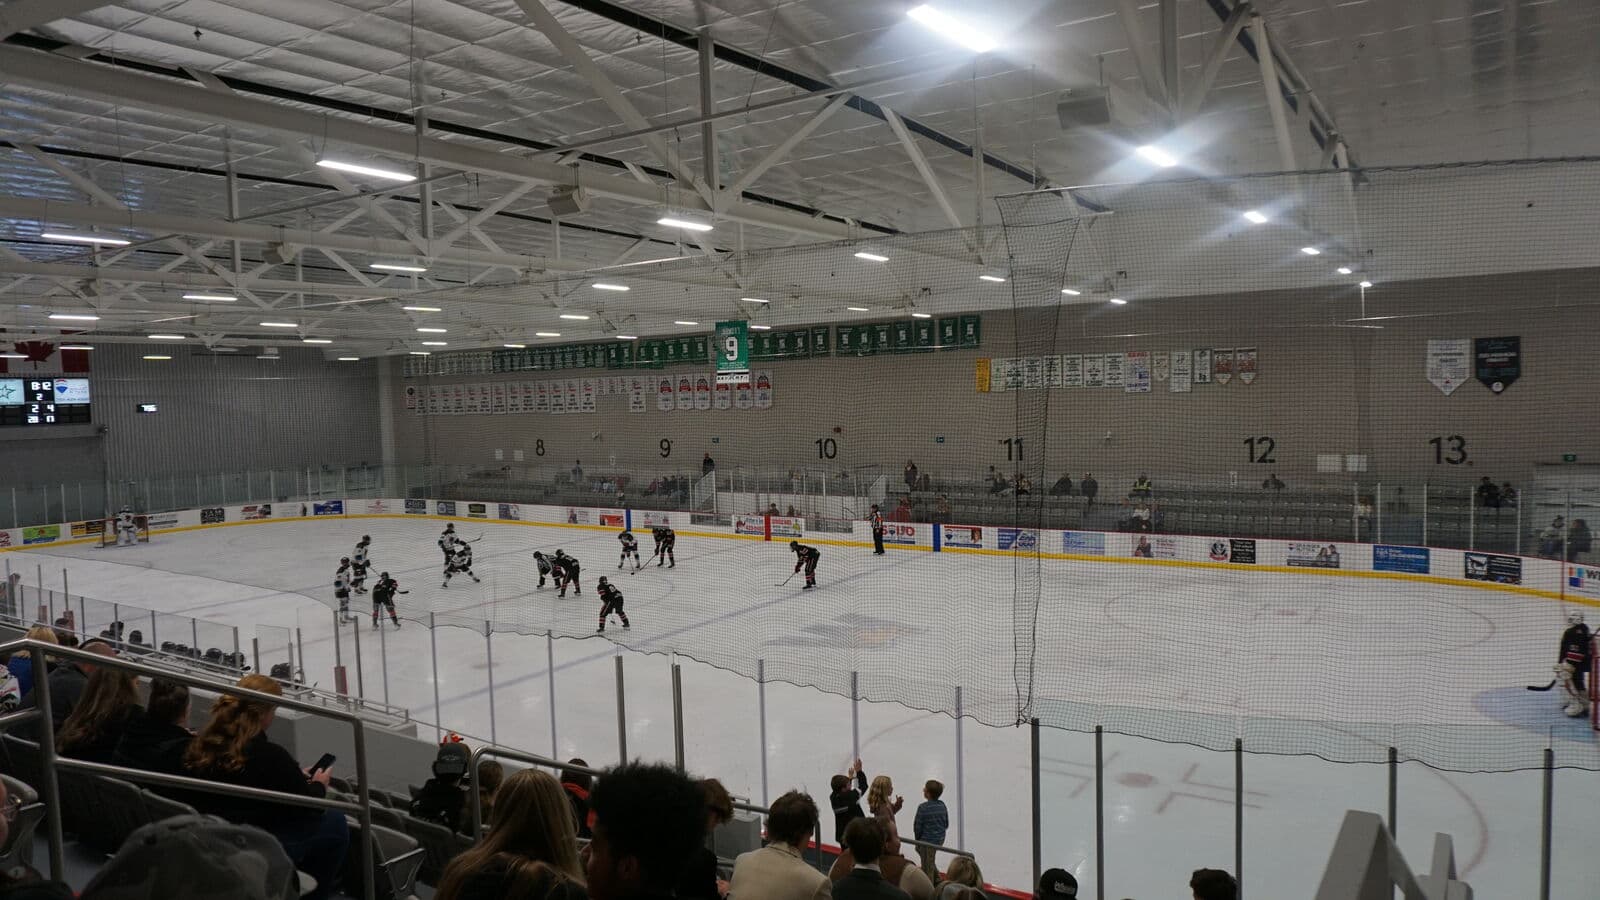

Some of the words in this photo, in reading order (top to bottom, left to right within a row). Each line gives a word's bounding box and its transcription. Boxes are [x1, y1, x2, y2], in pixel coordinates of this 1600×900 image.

[725, 336, 738, 361] 9
[46, 404, 55, 413] 4
[535, 438, 545, 457] 8
[659, 438, 671, 459] 9
[815, 438, 838, 460] 10
[1003, 437, 1026, 462] 11
[1243, 436, 1276, 464] 12
[1429, 435, 1468, 465] 13
